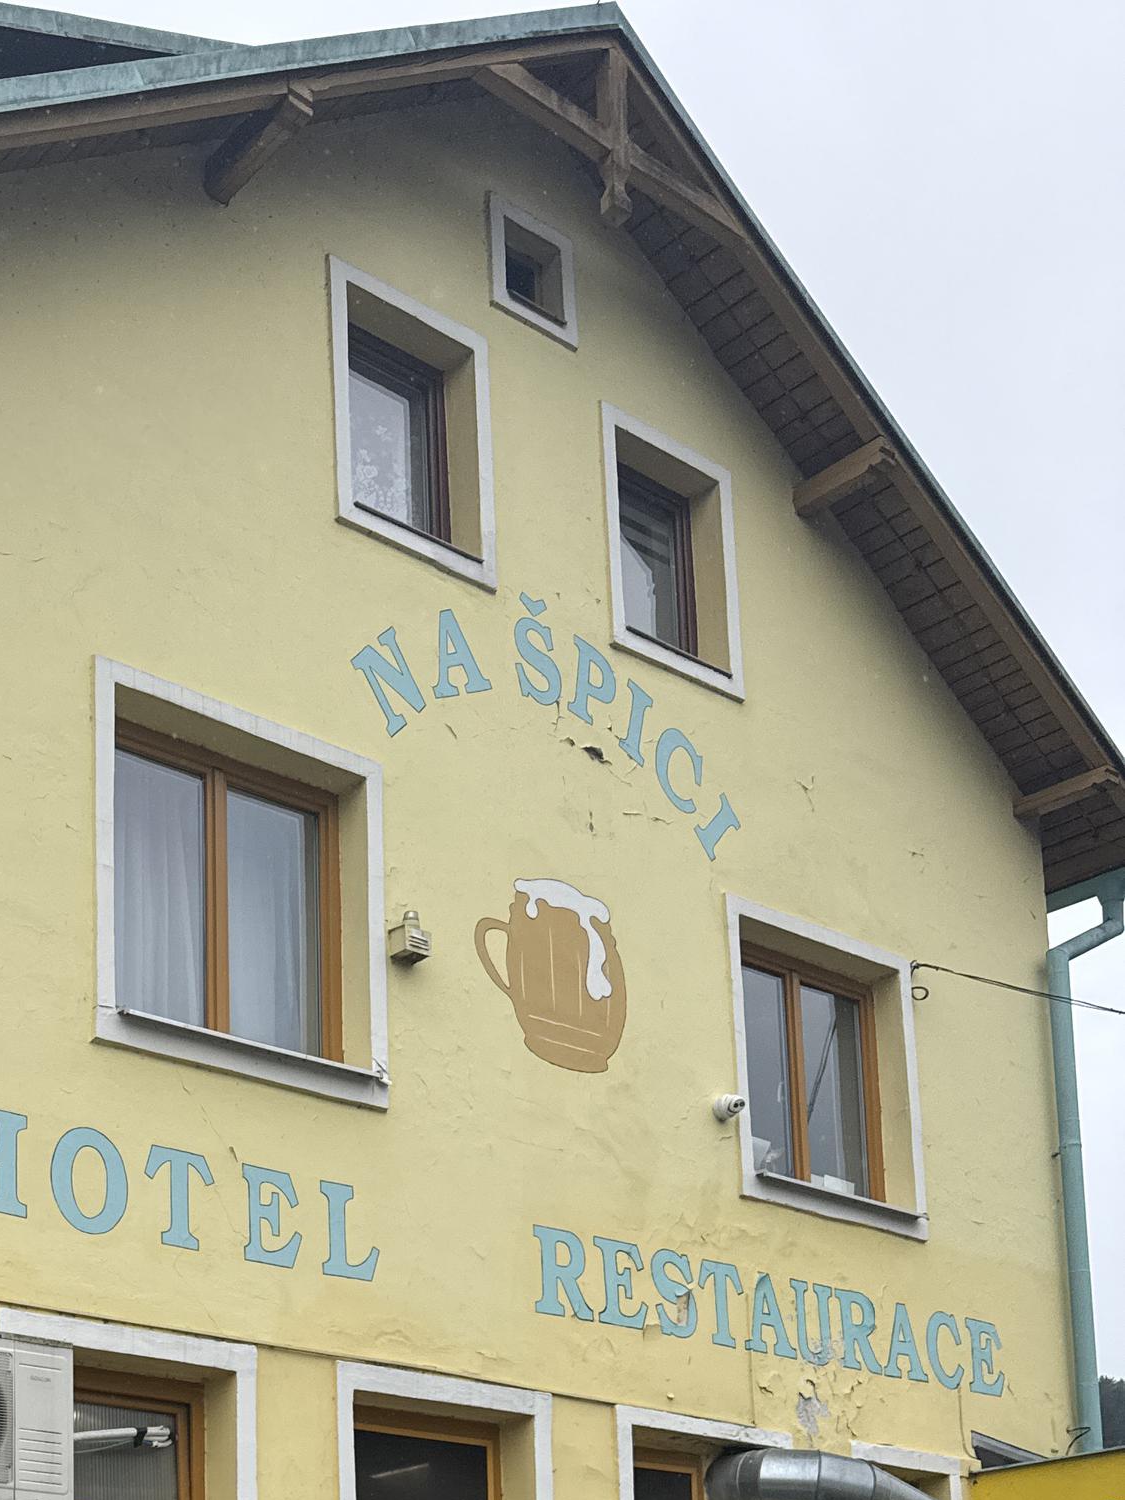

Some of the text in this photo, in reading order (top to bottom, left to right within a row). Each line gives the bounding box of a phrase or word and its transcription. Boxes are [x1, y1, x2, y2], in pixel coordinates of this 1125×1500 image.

[350, 592, 741, 862] NA ŠPICI
[533, 1224, 1005, 1397] RESTAURACE
